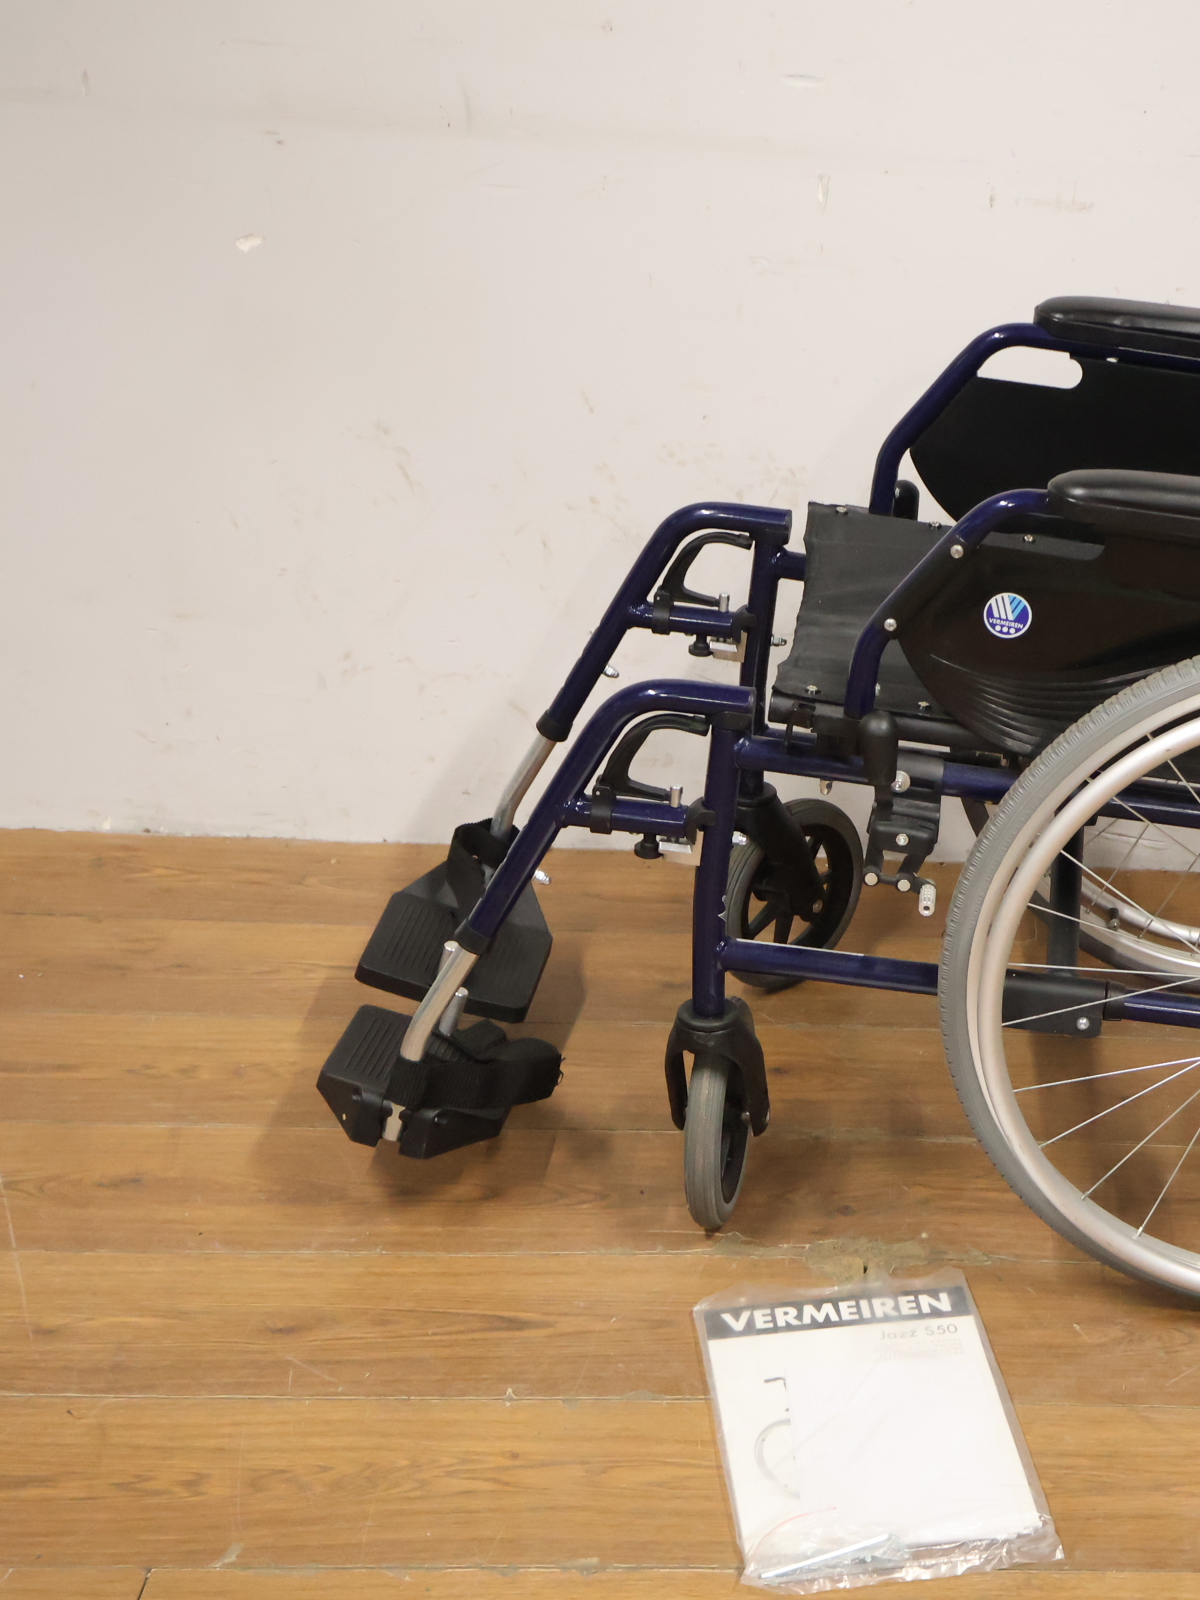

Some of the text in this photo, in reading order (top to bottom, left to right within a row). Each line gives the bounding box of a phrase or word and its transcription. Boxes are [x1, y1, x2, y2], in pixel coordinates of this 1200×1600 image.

[988, 617, 1024, 630] VERMEIREN
[720, 1292, 953, 1332] VERMEIREN
[880, 1323, 959, 1341] Jazz S50
